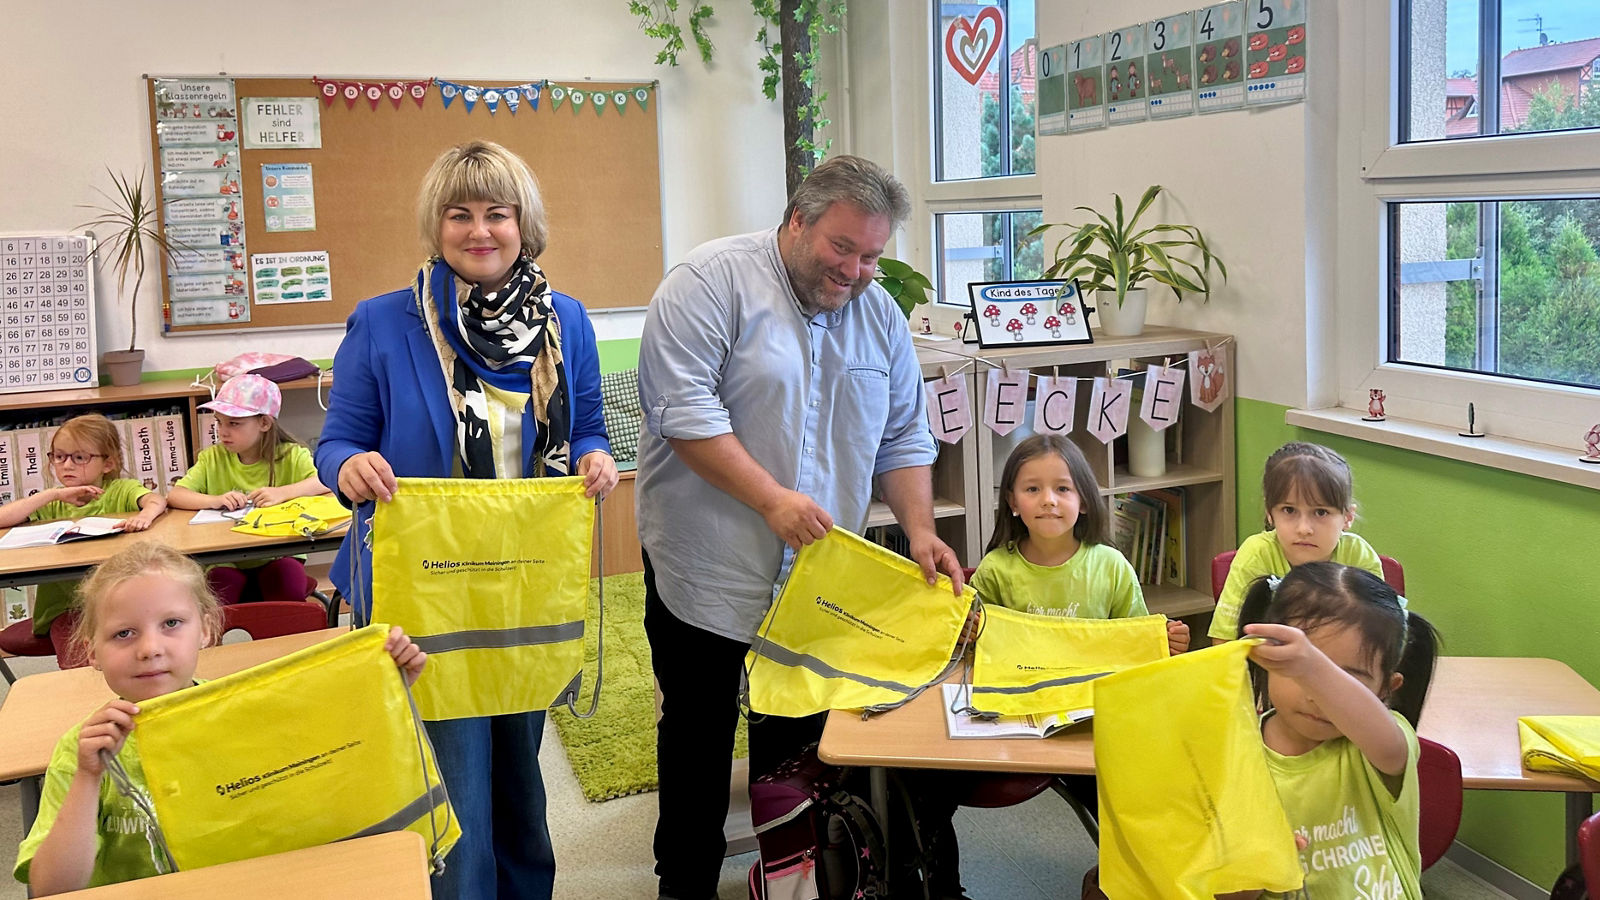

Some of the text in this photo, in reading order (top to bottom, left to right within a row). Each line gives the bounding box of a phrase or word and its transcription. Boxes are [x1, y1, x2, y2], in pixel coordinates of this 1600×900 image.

[1042, 0, 1274, 77] 0 1 2 3 4 5
[180, 83, 211, 92] Unsere
[165, 92, 227, 102] Klassenregeln
[257, 104, 303, 116] FEHLER
[272, 118, 292, 128] sind
[259, 131, 305, 143] HELFER
[990, 288, 1066, 298] Kind des Tages
[9, 375, 20, 383] 96
[138, 426, 153, 472] Elizabeth
[166, 420, 179, 472] Emma-Luise
[26, 447, 38, 475] Thalia
[431, 561, 460, 569] Helios
[822, 599, 843, 614] Helios
[1047, 602, 1080, 617] macht
[226, 775, 261, 793] Helios
[1313, 805, 1358, 842] macht
[1311, 834, 1387, 872] CHRONE
